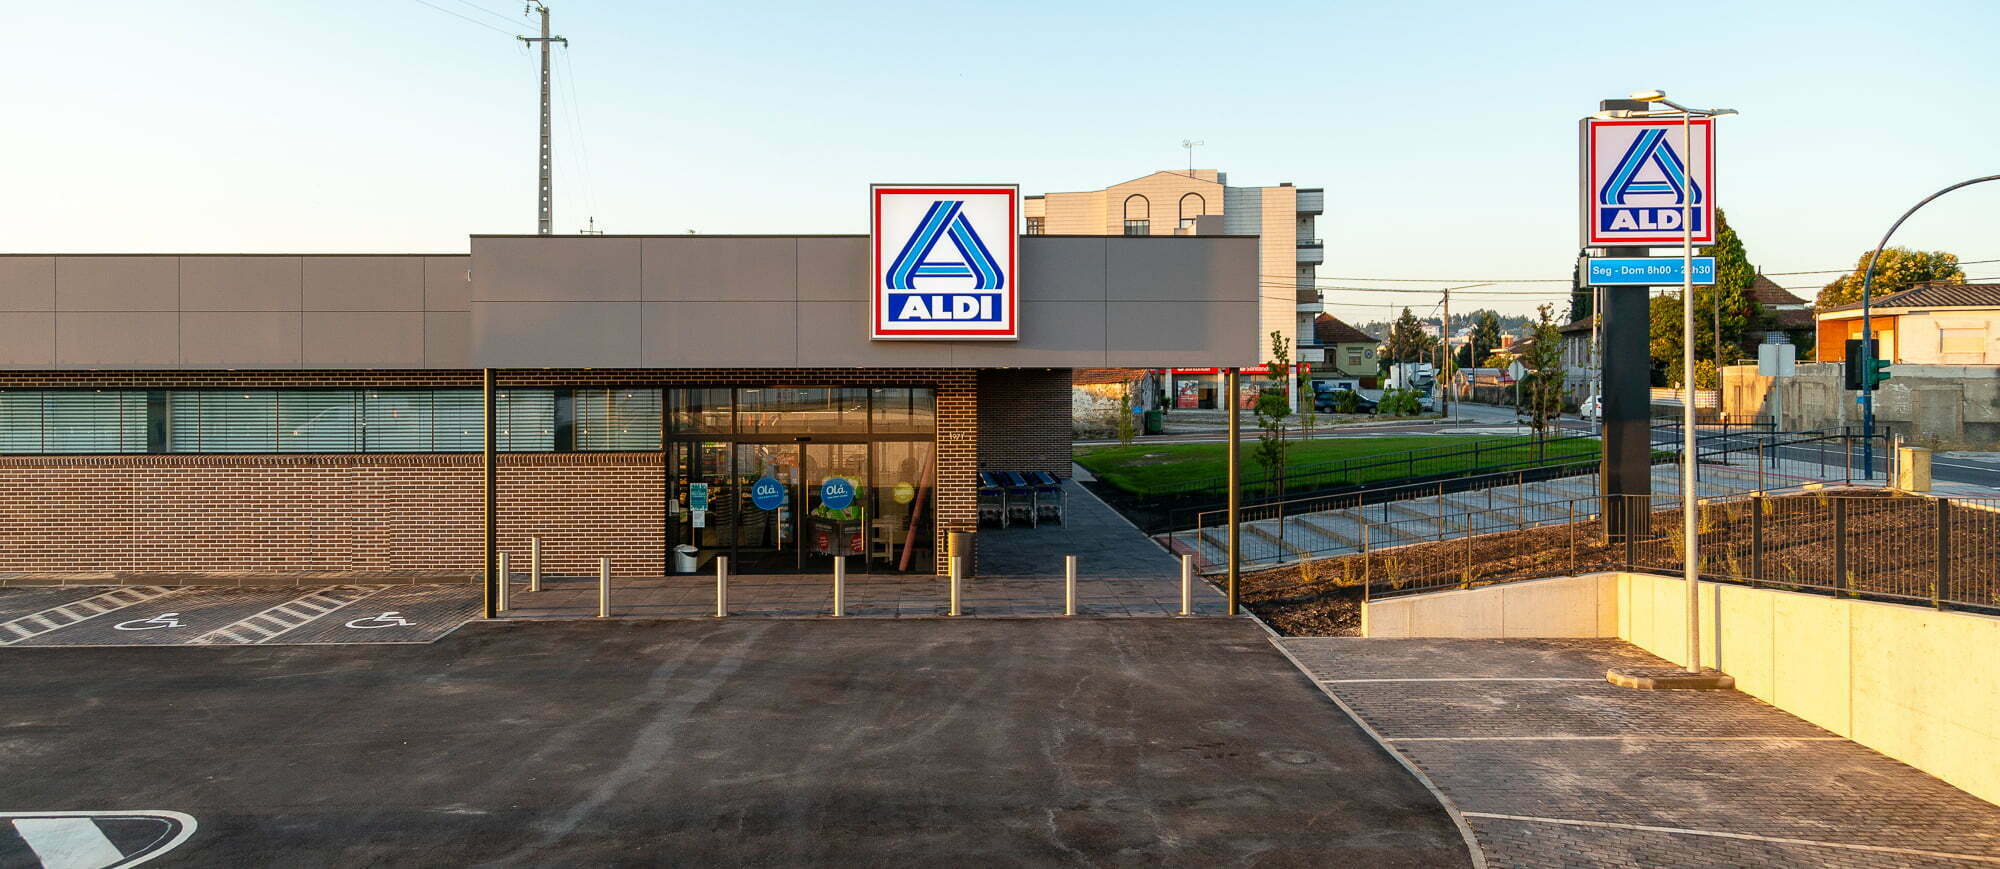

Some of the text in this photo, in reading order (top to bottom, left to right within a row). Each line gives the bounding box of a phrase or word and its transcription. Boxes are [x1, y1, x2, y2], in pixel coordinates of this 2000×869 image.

[1592, 266, 1612, 276] Seg
[1621, 266, 1645, 275] Dom
[1647, 266, 1671, 275] 8h00
[1680, 265, 1711, 275] 2h30
[898, 295, 993, 320] ALDI
